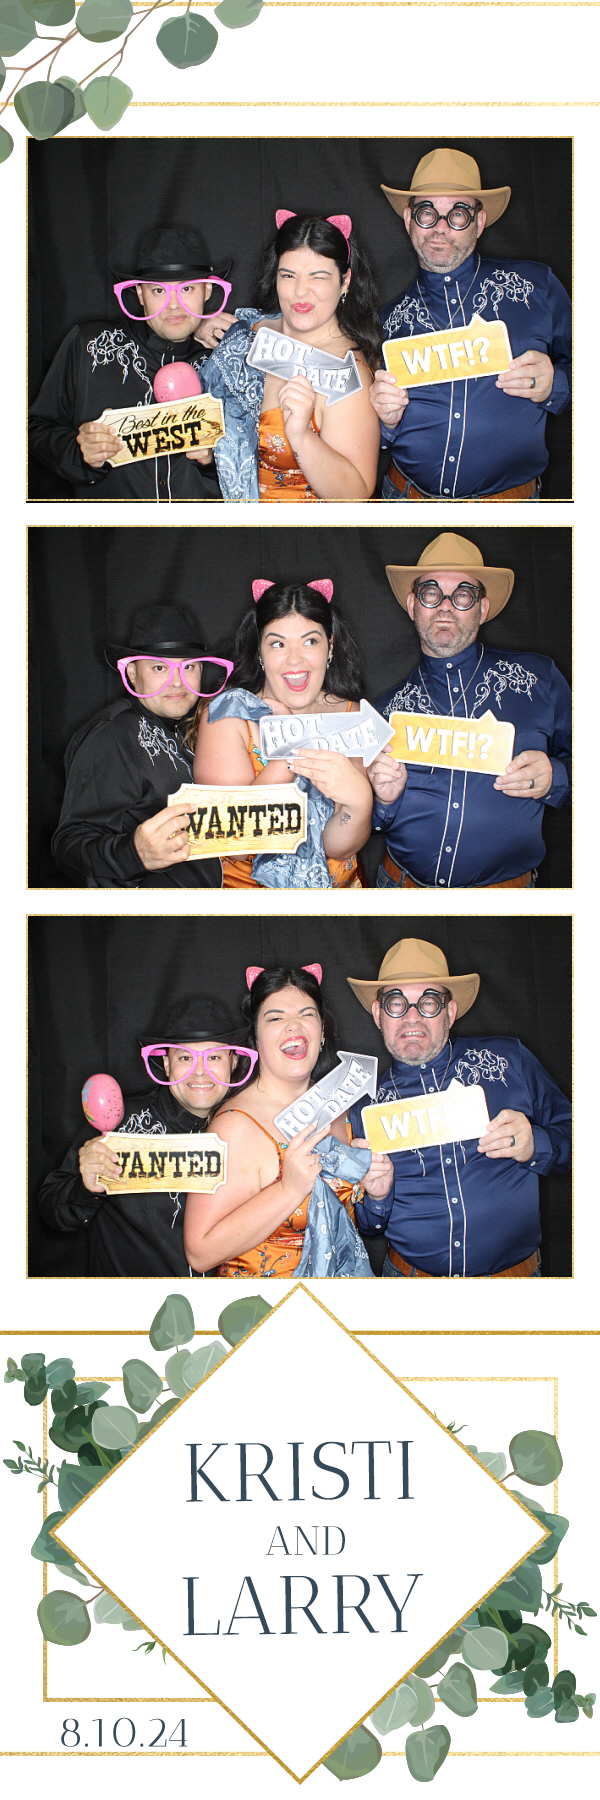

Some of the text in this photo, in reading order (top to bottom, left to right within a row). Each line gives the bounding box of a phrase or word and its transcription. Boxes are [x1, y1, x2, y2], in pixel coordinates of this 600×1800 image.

[252, 333, 314, 364] HOT
[401, 337, 490, 375] WTF!?
[117, 404, 206, 434] Best in the
[122, 420, 202, 457] WEST
[262, 714, 322, 755] HOT
[312, 714, 380, 751] DATE
[406, 725, 494, 760] WTF!?
[322, 1058, 372, 1117] DATE
[277, 1086, 327, 1139] HOT
[379, 1103, 455, 1140] WTF
